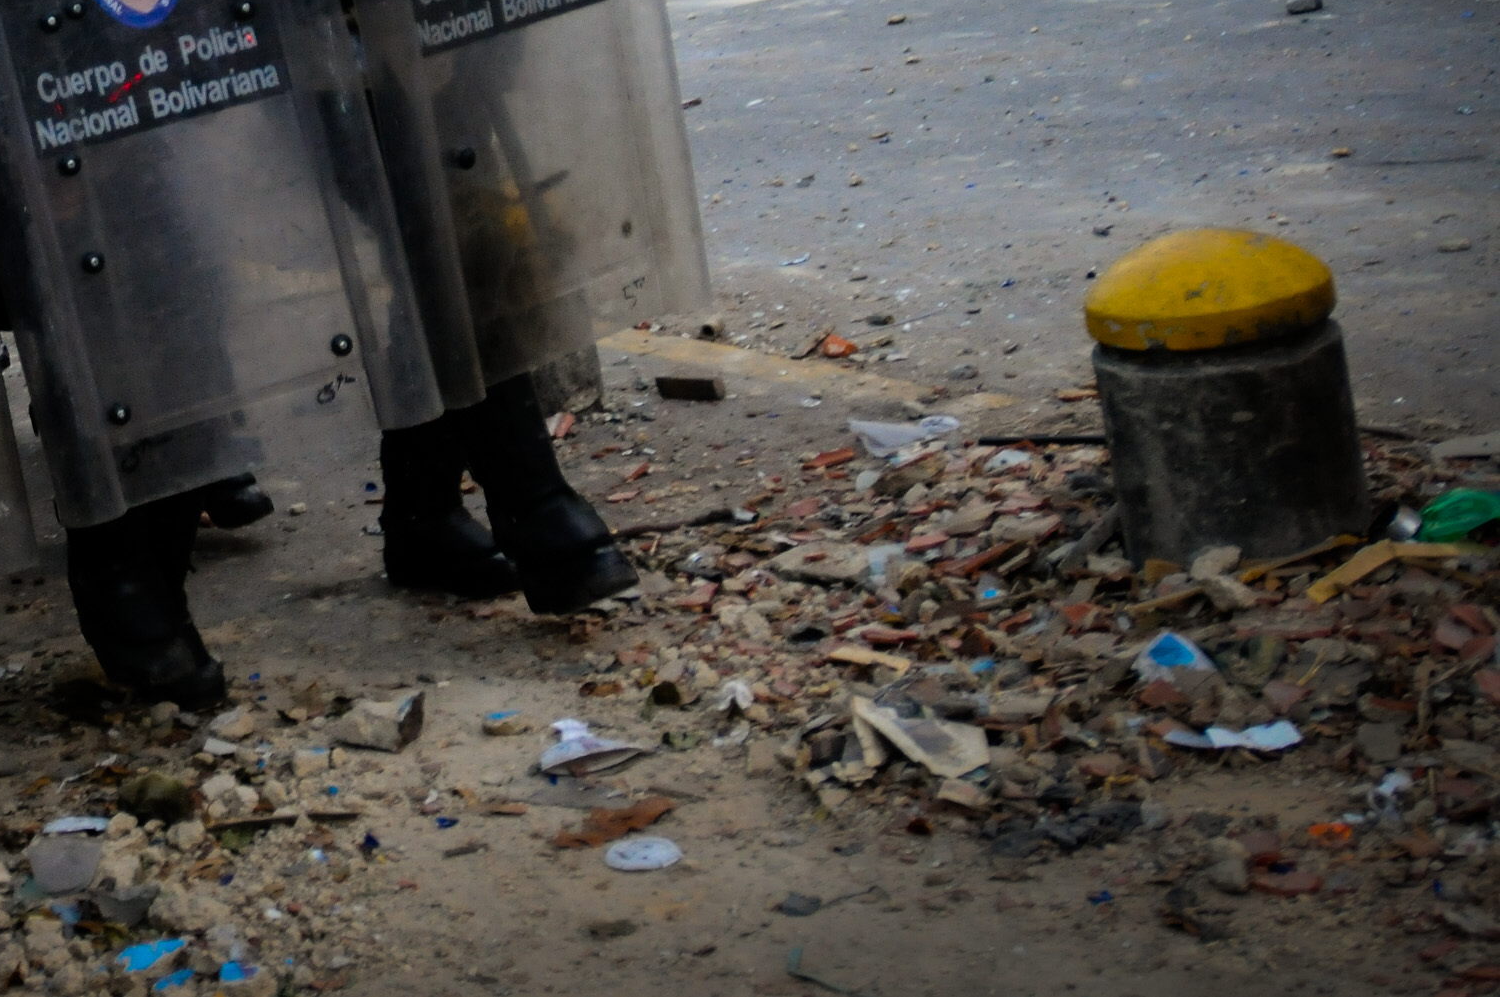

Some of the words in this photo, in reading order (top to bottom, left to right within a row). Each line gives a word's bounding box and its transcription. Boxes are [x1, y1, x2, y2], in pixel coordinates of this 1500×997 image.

[418, 1, 493, 46] Nacional
[37, 61, 126, 103] Cuerpo
[139, 45, 168, 76] de
[36, 97, 139, 150] Nacional
[149, 64, 280, 119] Bolivariana
